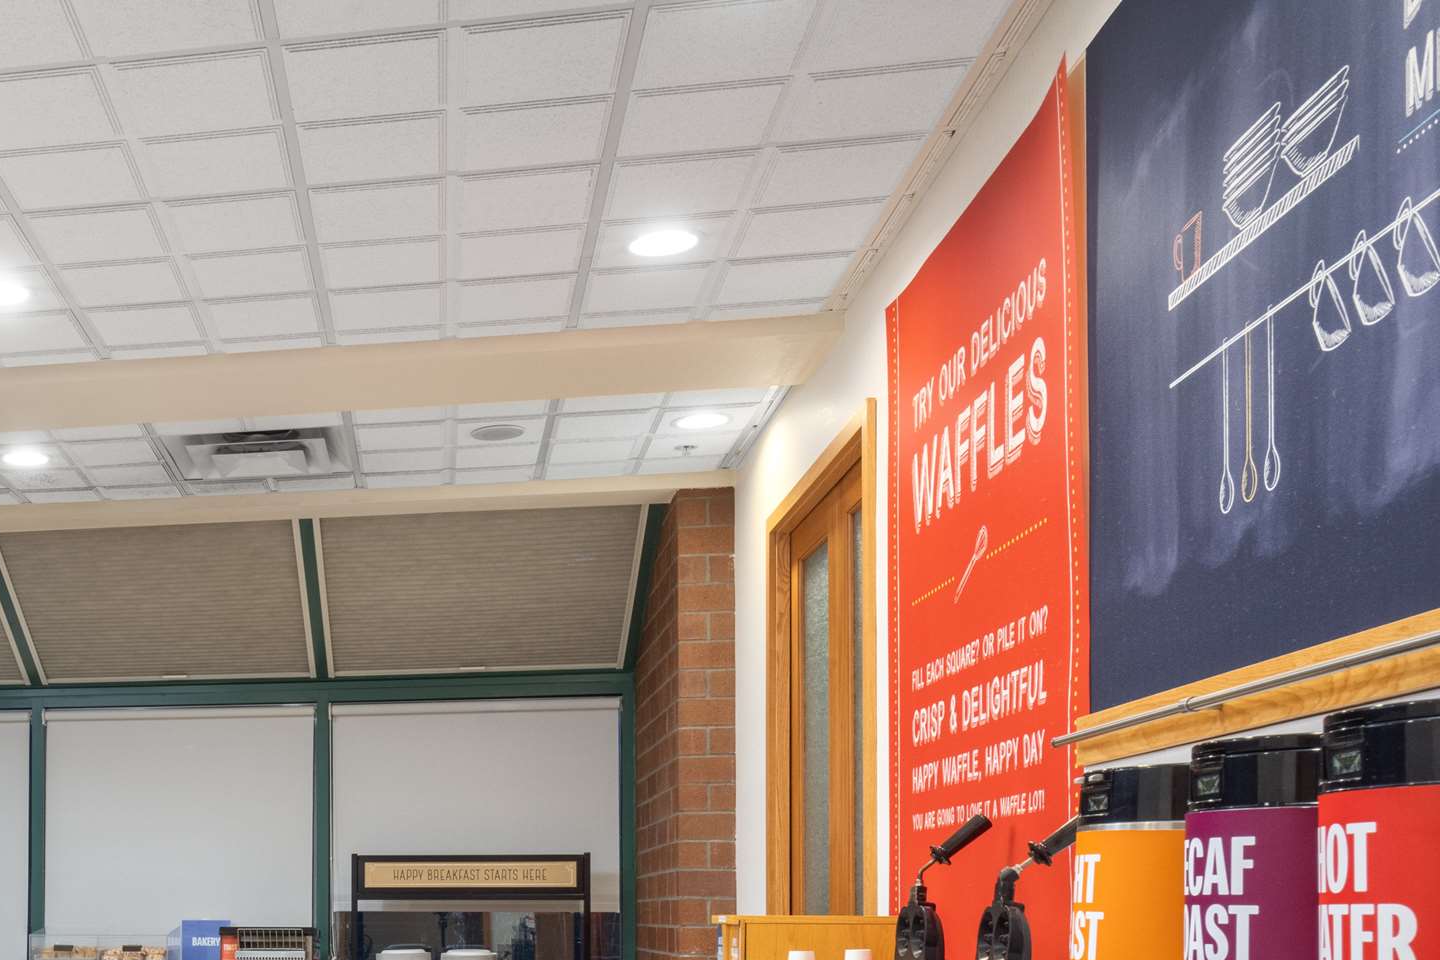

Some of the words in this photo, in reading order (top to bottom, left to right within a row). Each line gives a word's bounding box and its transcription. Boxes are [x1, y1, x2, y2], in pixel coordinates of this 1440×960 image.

[912, 377, 934, 432] TRY
[939, 345, 966, 405] OUR
[971, 257, 1047, 377] DELICIOUS
[912, 336, 1048, 534] WAFFLES
[912, 667, 924, 692] FILL
[926, 657, 944, 686] EACH
[946, 639, 980, 676] SQUARE?
[982, 632, 994, 658] OR
[997, 622, 1015, 653] PILE
[1017, 616, 1026, 643] IT
[1029, 605, 1048, 638] ON?
[912, 700, 945, 747] CRISP
[949, 694, 957, 734] &
[962, 659, 1047, 731] DELIGHTFUL
[912, 761, 939, 793] HAPPY
[942, 749, 981, 786] WAFFLE,
[985, 737, 1019, 776] HAPPY
[1023, 729, 1045, 768] DAY
[912, 813, 923, 831] YOU
[924, 811, 935, 829] ARE
[937, 807, 954, 826] GOING
[957, 805, 964, 823] TO
[993, 800, 998, 819] A
[1000, 793, 1026, 816] WAFFLE
[1028, 789, 1045, 813] LOT!
[393, 869, 423, 881] HAPPY
[427, 869, 480, 881] BREAKFAST
[483, 869, 519, 881] STARTS
[522, 869, 548, 881] HERE
[192, 936, 221, 947] BAKERY
